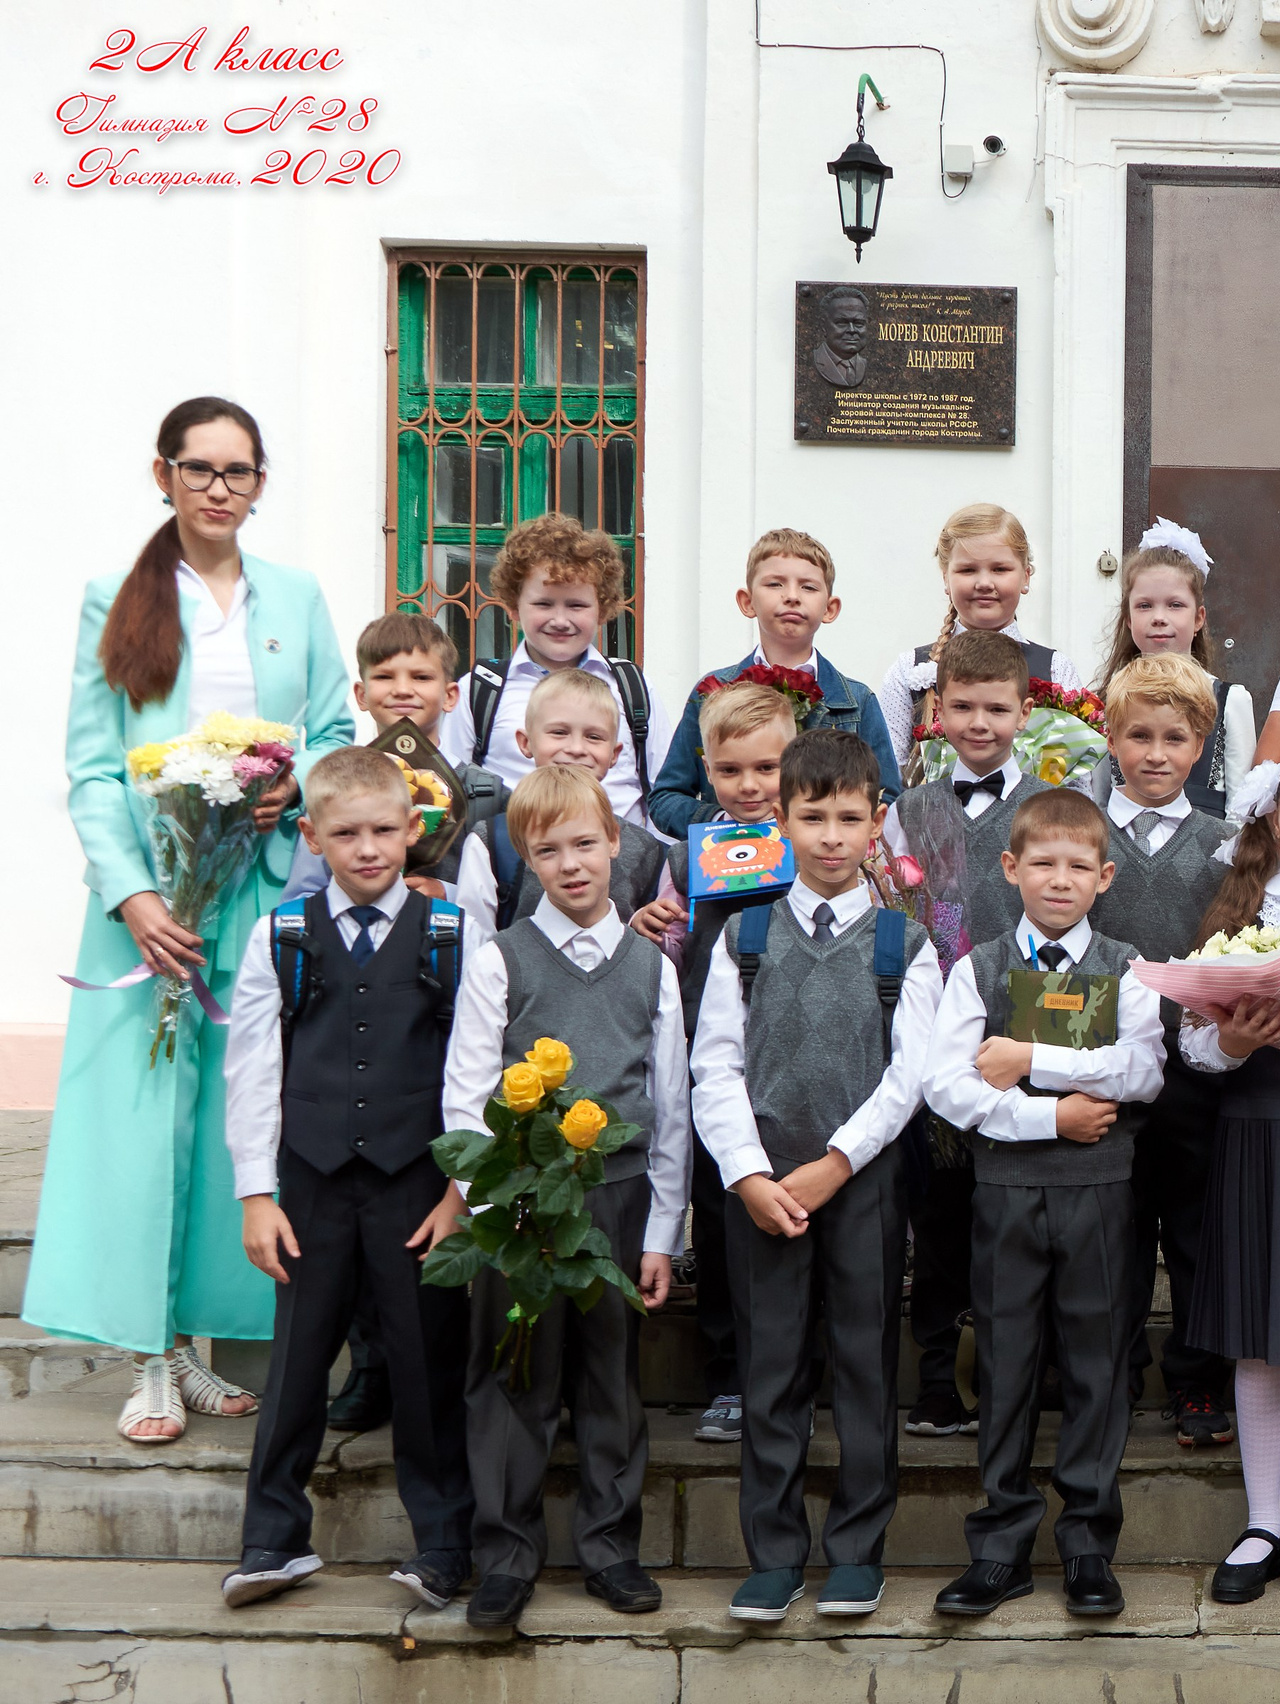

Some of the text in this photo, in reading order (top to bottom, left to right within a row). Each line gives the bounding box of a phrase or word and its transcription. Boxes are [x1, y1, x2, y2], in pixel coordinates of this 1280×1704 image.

[878, 323, 1004, 344] МОРЕВ КОНСТАНТИН
[906, 349, 975, 372] АНДРЕЕВИЧ
[834, 391, 872, 400] Директор
[909, 393, 927, 401] 1972
[838, 400, 881, 409] Инициатор
[840, 409, 874, 417] хоровой
[830, 417, 885, 426] Заслуженный
[826, 426, 867, 434] Почетный
[940, 429, 983, 437] Костромы.
